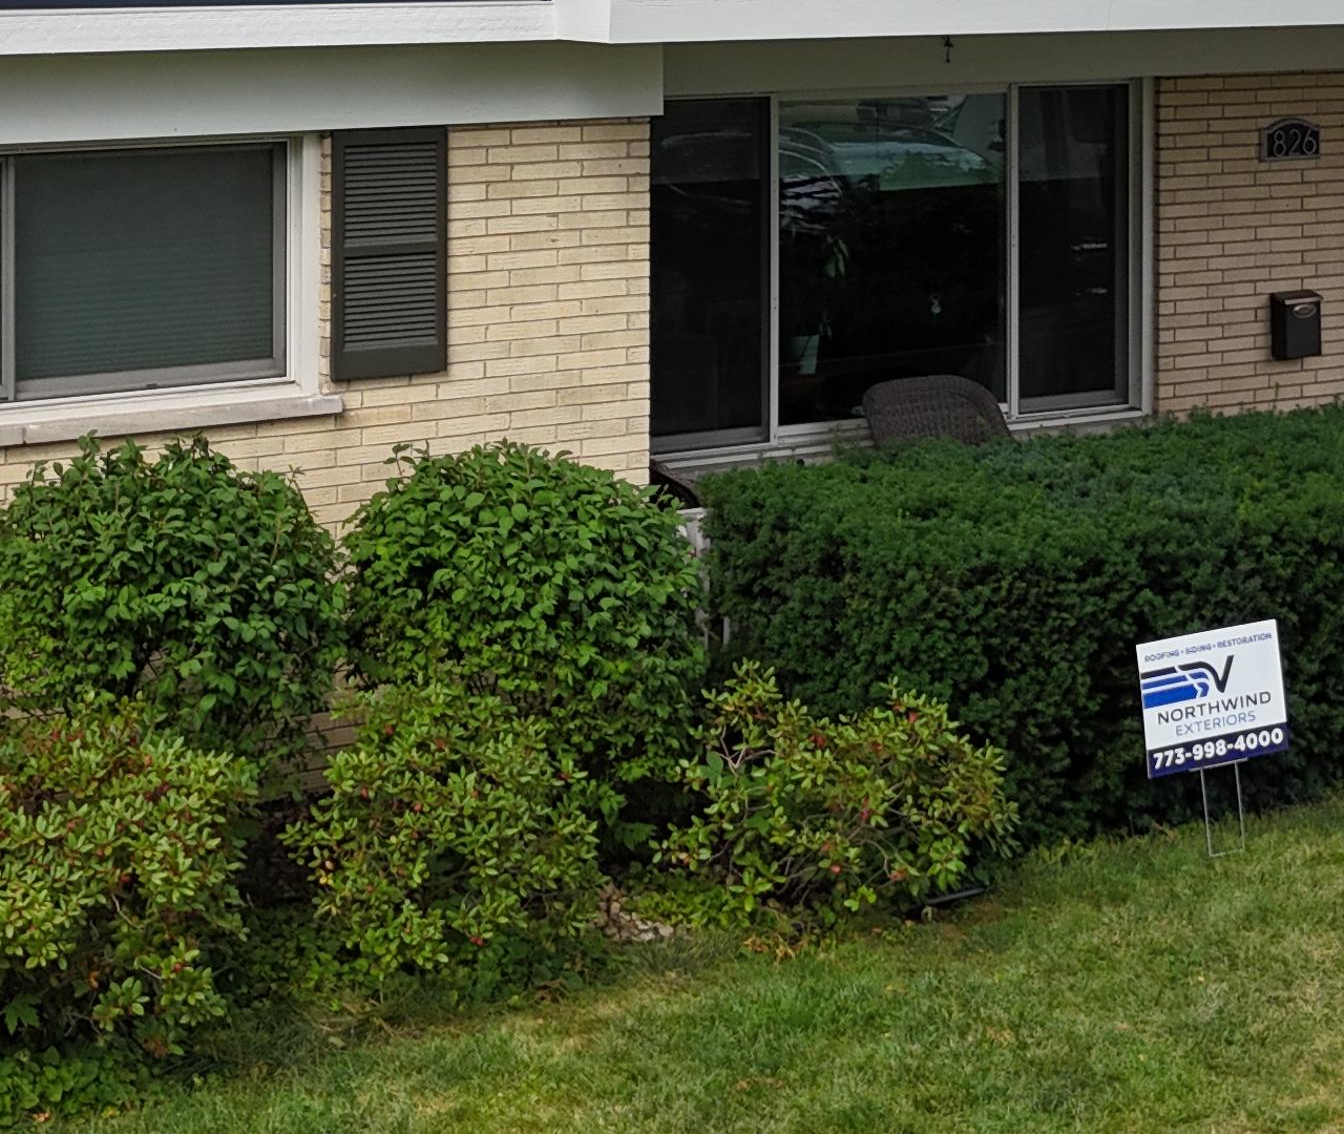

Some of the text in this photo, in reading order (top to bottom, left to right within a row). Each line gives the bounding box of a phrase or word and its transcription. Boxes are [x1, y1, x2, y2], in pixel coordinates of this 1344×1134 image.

[1273, 128, 1317, 157] 826
[1144, 632, 1273, 663] ROOFING SIDING RESTORATION
[1157, 691, 1272, 725] NORTHWIND
[1175, 710, 1256, 736] EXTERIORS
[1153, 728, 1284, 770] 773-998-4000
